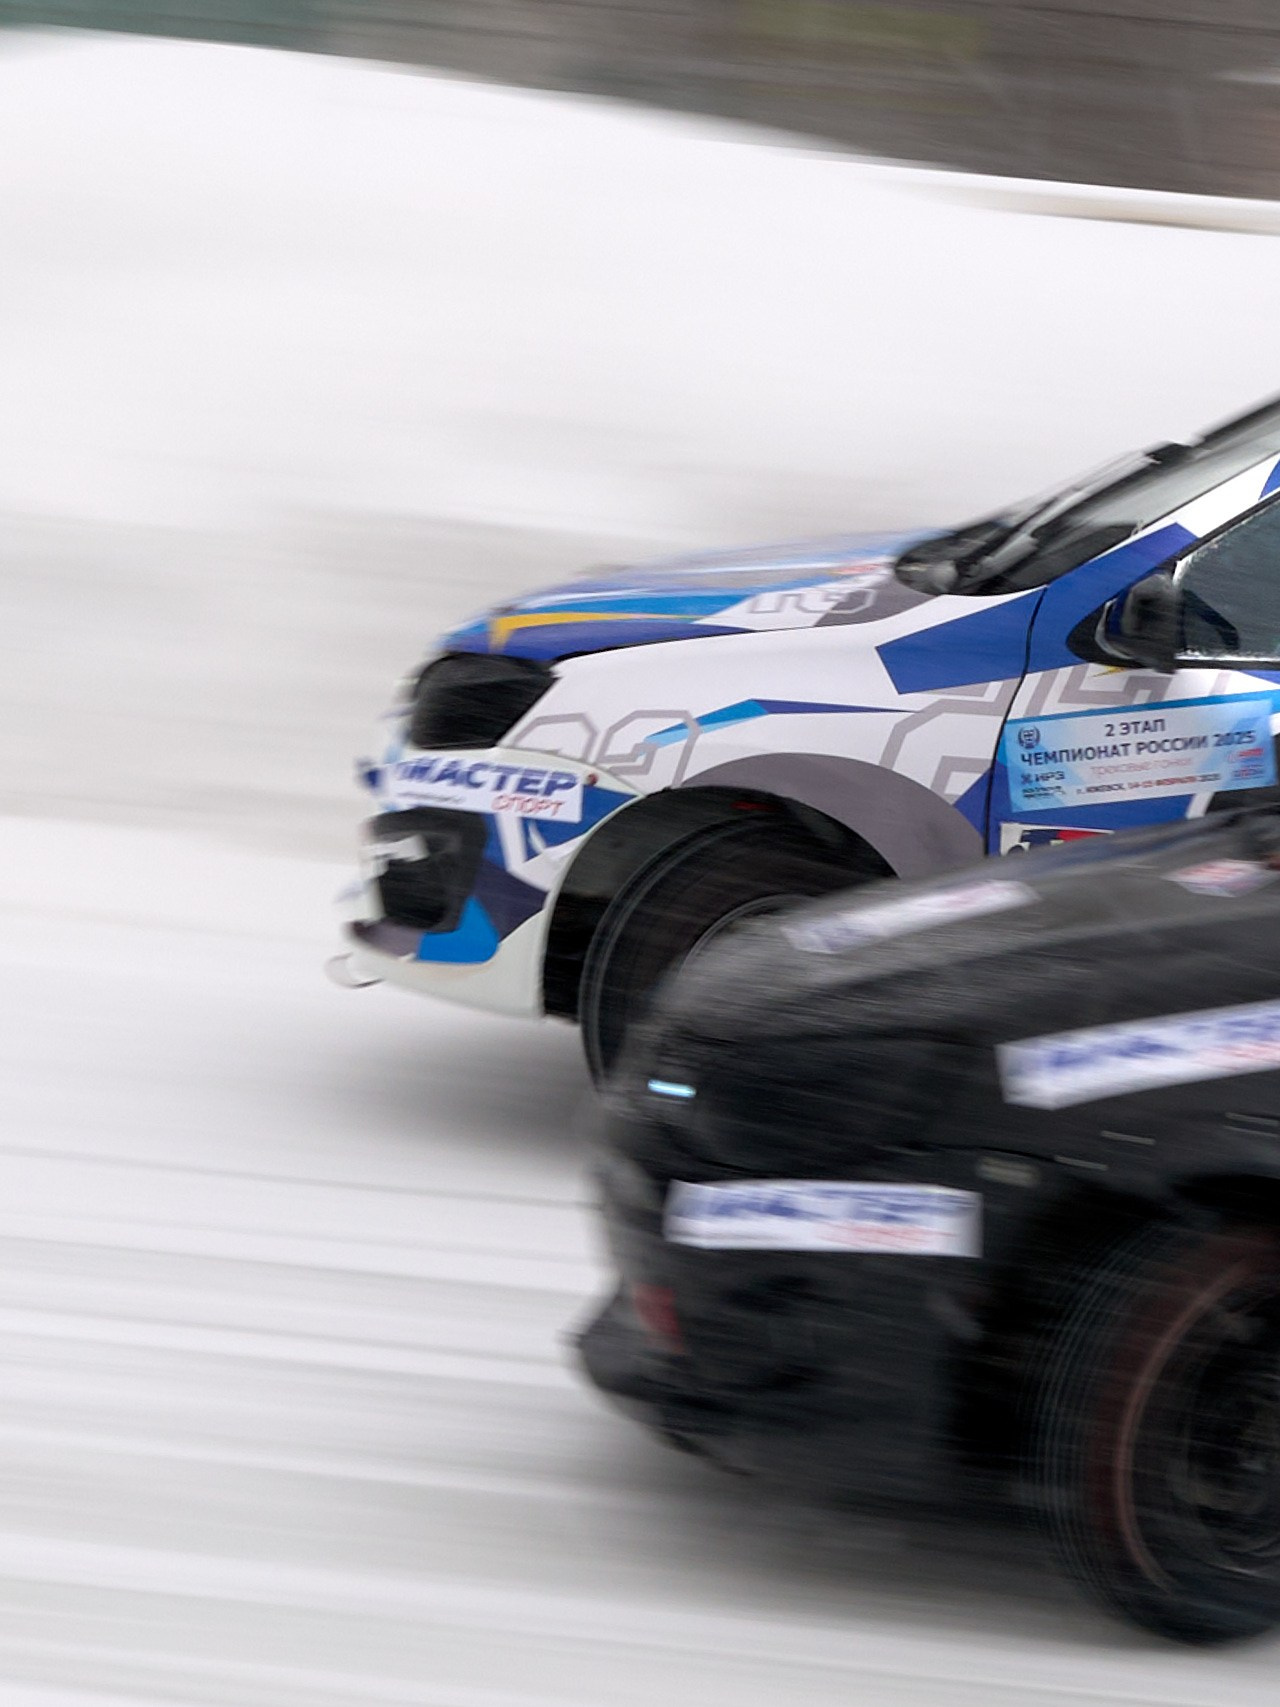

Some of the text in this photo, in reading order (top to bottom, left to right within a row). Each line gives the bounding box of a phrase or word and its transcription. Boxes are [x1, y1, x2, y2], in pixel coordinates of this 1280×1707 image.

[1104, 718, 1166, 737] 2 ЭТАП
[1021, 729, 1257, 767] ЧЕМПИОНАТ РОССИИ 2025
[491, 794, 566, 817] СПОРТ
